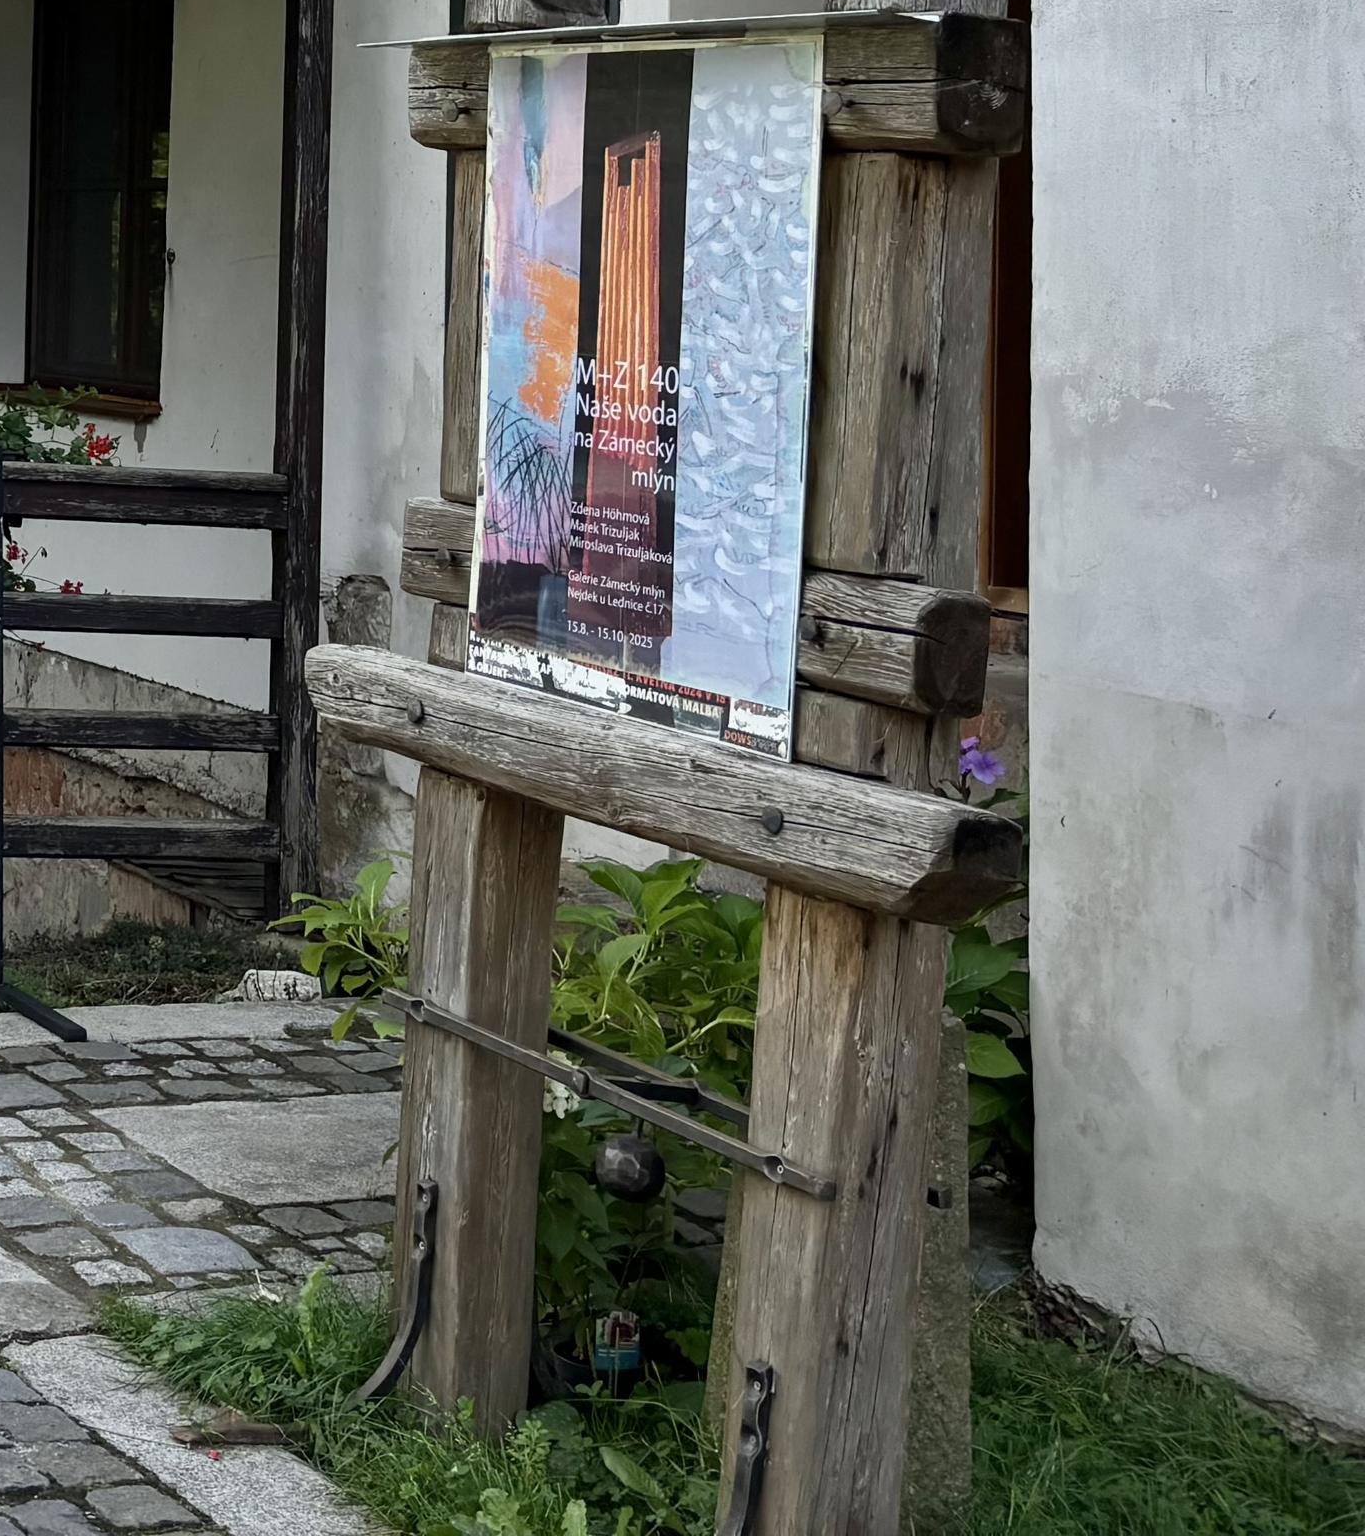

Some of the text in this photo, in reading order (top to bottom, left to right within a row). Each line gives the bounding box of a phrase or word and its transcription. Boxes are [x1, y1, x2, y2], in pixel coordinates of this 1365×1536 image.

[577, 357, 679, 394] M+Z 140
[576, 392, 676, 426] Naše voda
[574, 430, 675, 463] na Zámecký
[631, 467, 674, 494] mlýn
[571, 501, 650, 525] Zdena Höhmová
[570, 519, 640, 542] Marek Trizuljak
[569, 535, 673, 564] Miroslava Trizuljaková
[568, 569, 665, 599] Galerie Zámecký mlýn
[567, 586, 598, 602] Nejdek
[608, 594, 644, 612] Lednice
[629, 632, 653, 648] 2025
[623, 684, 680, 709] ORMÁTOVÁ
